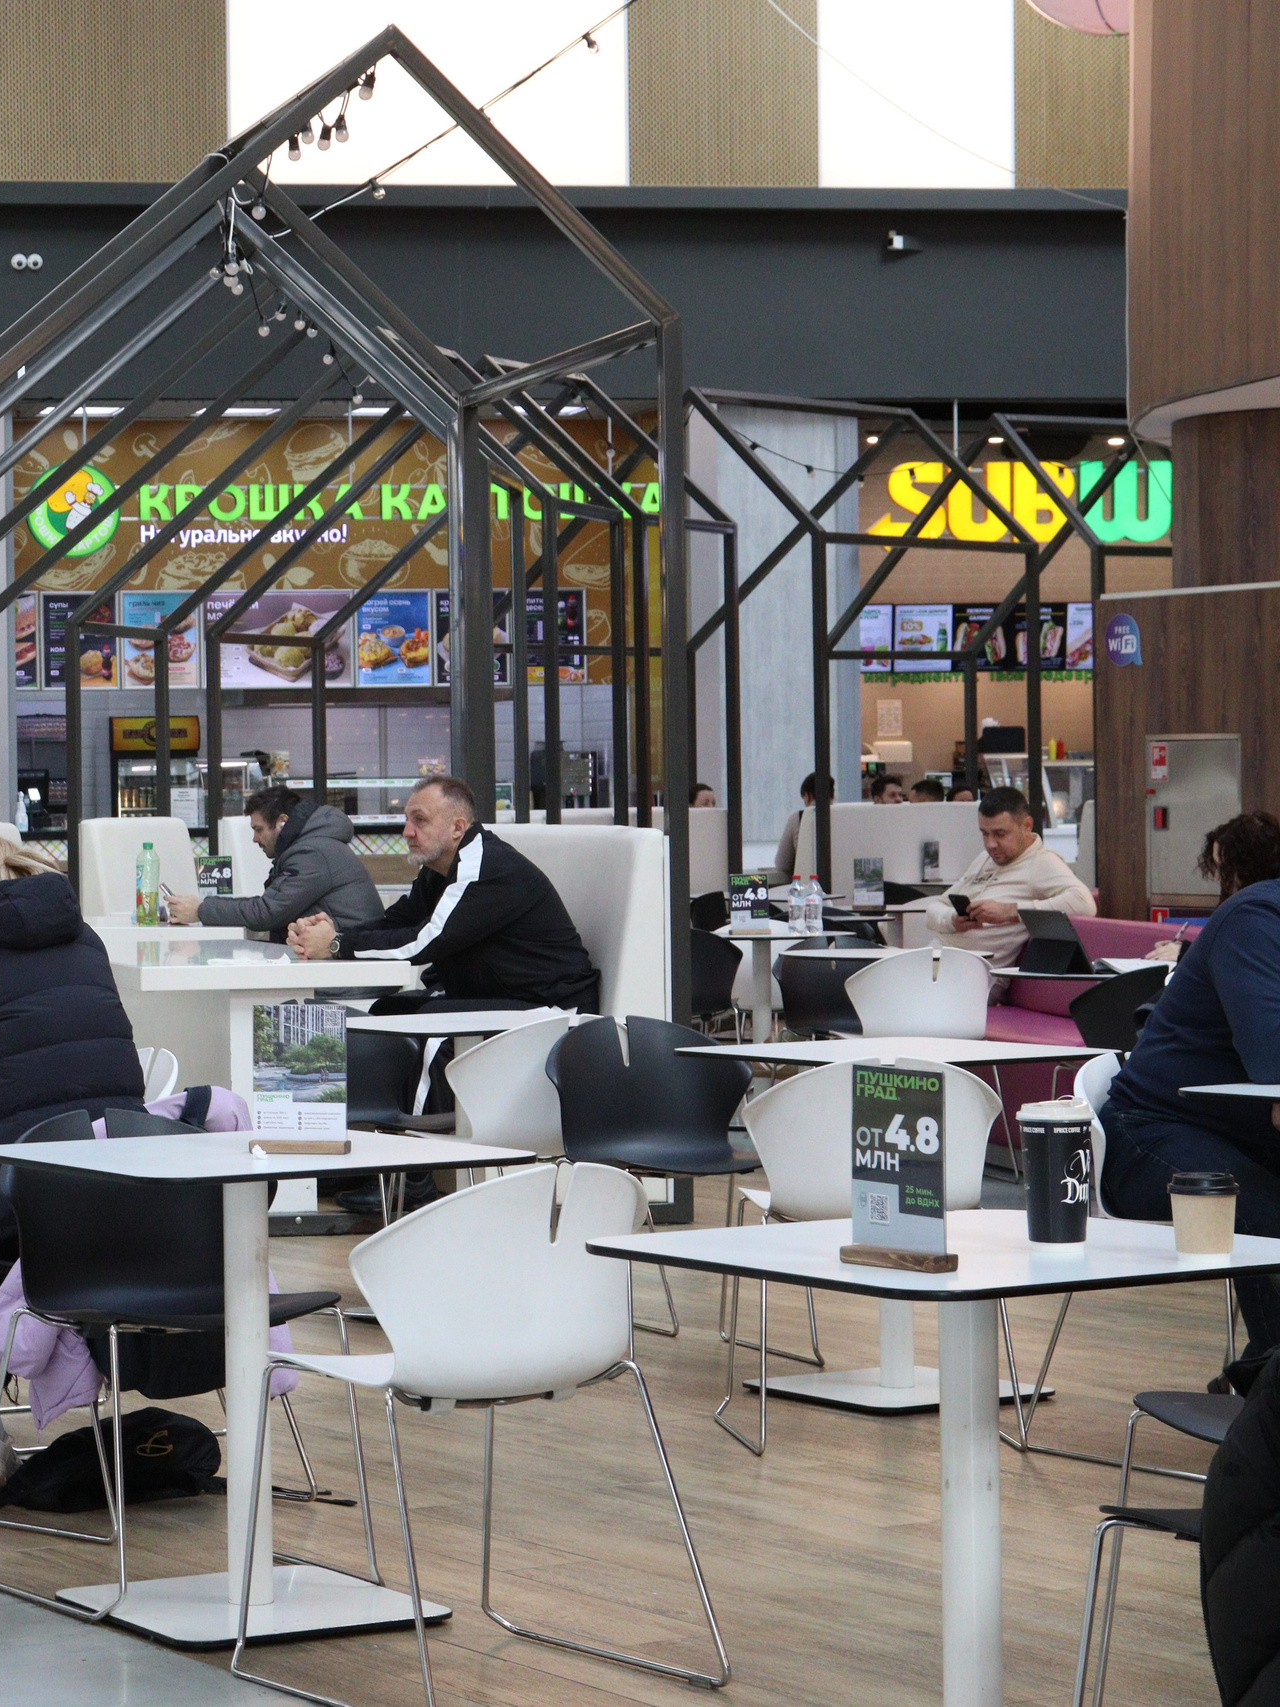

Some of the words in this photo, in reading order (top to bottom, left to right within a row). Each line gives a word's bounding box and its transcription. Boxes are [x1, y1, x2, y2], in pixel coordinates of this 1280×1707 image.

[139, 483, 364, 521] КРОШКА
[867, 460, 1173, 550] SUBW
[140, 524, 261, 548] Нурально
[270, 524, 348, 543] вкуно!
[211, 867, 231, 878] 4.8
[732, 900, 752, 908] МЛН
[744, 887, 768, 900] 4.8
[856, 1070, 940, 1092] ПУШКИНО
[856, 1126, 883, 1147] ОТ
[884, 1113, 940, 1155] 4.8
[855, 1148, 900, 1172] МЛН
[905, 1184, 915, 1194] 25
[905, 1197, 916, 1205] до
[917, 1197, 940, 1208] ВДНХ
